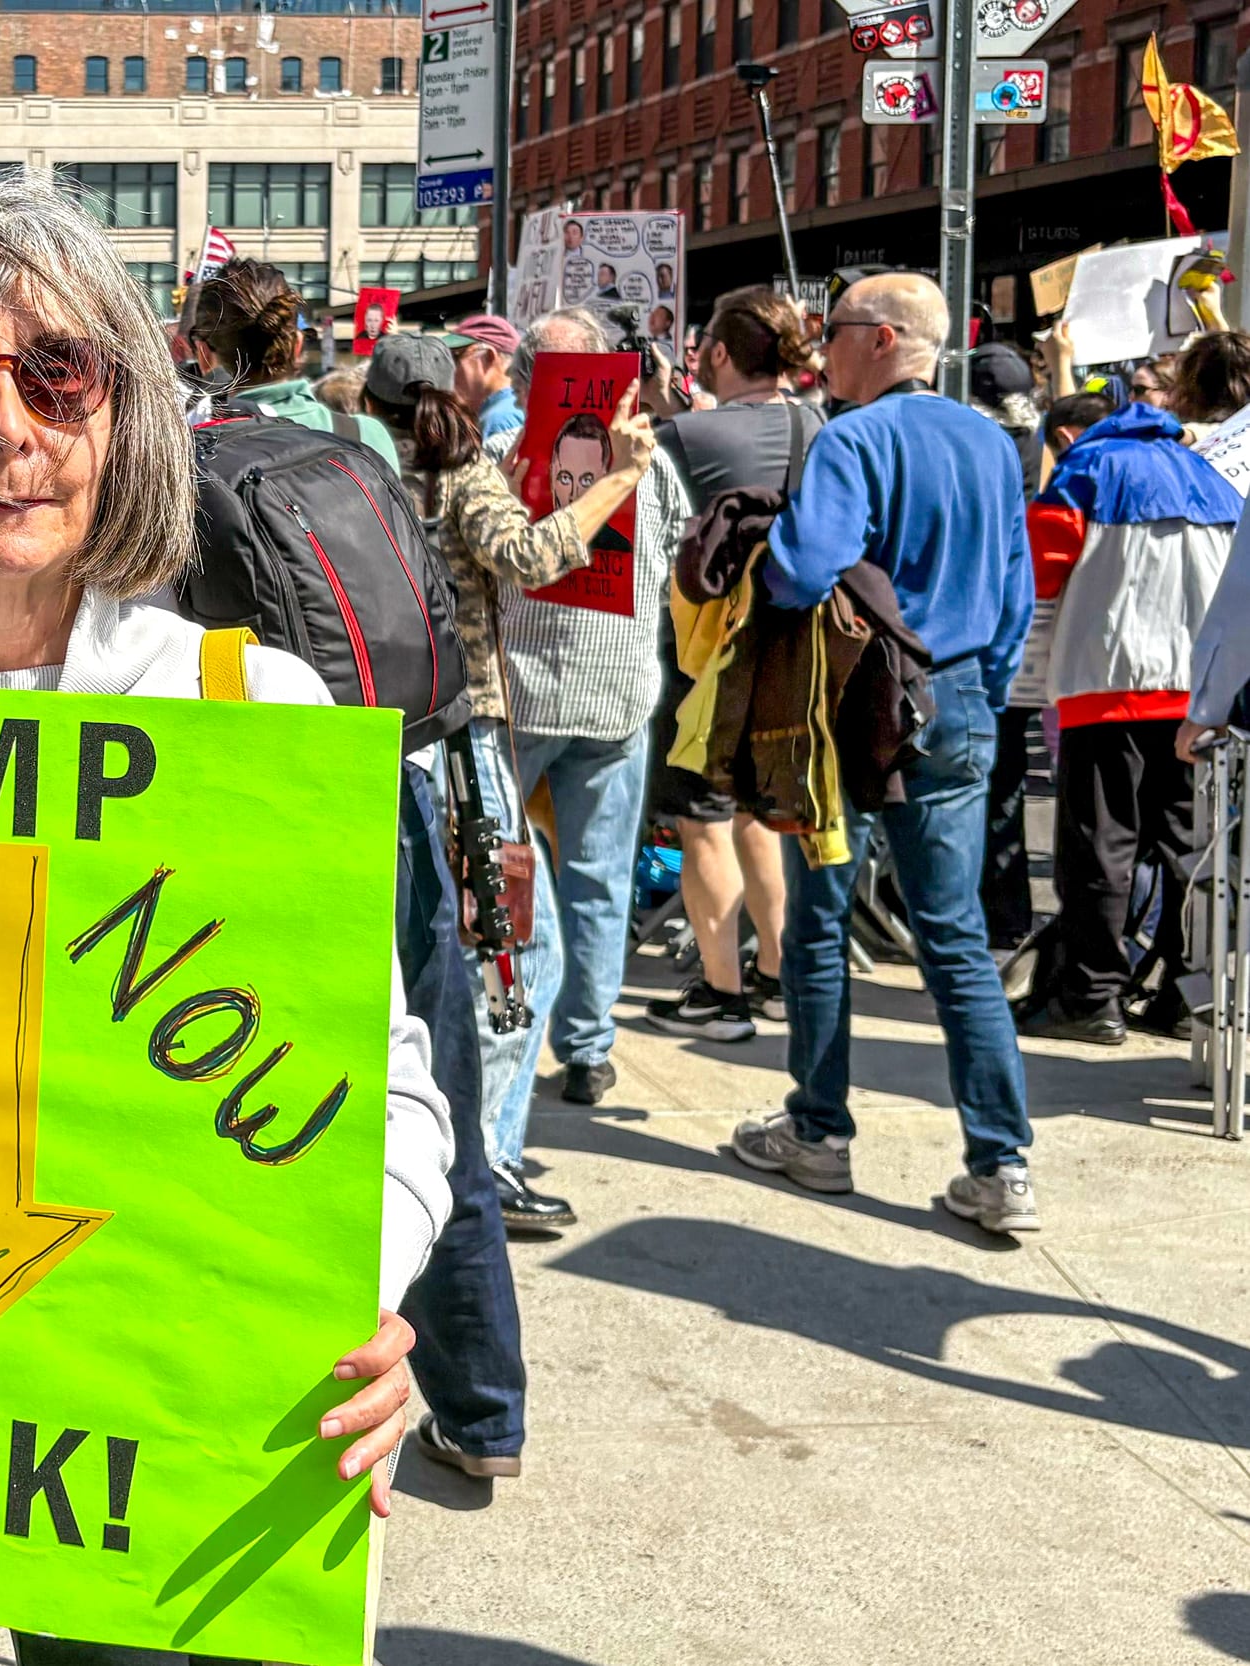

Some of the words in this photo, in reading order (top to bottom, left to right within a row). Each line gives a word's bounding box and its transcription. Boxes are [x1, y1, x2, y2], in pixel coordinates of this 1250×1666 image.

[429, 33, 444, 60] 2
[558, 376, 577, 408] I
[581, 378, 614, 410] AM
